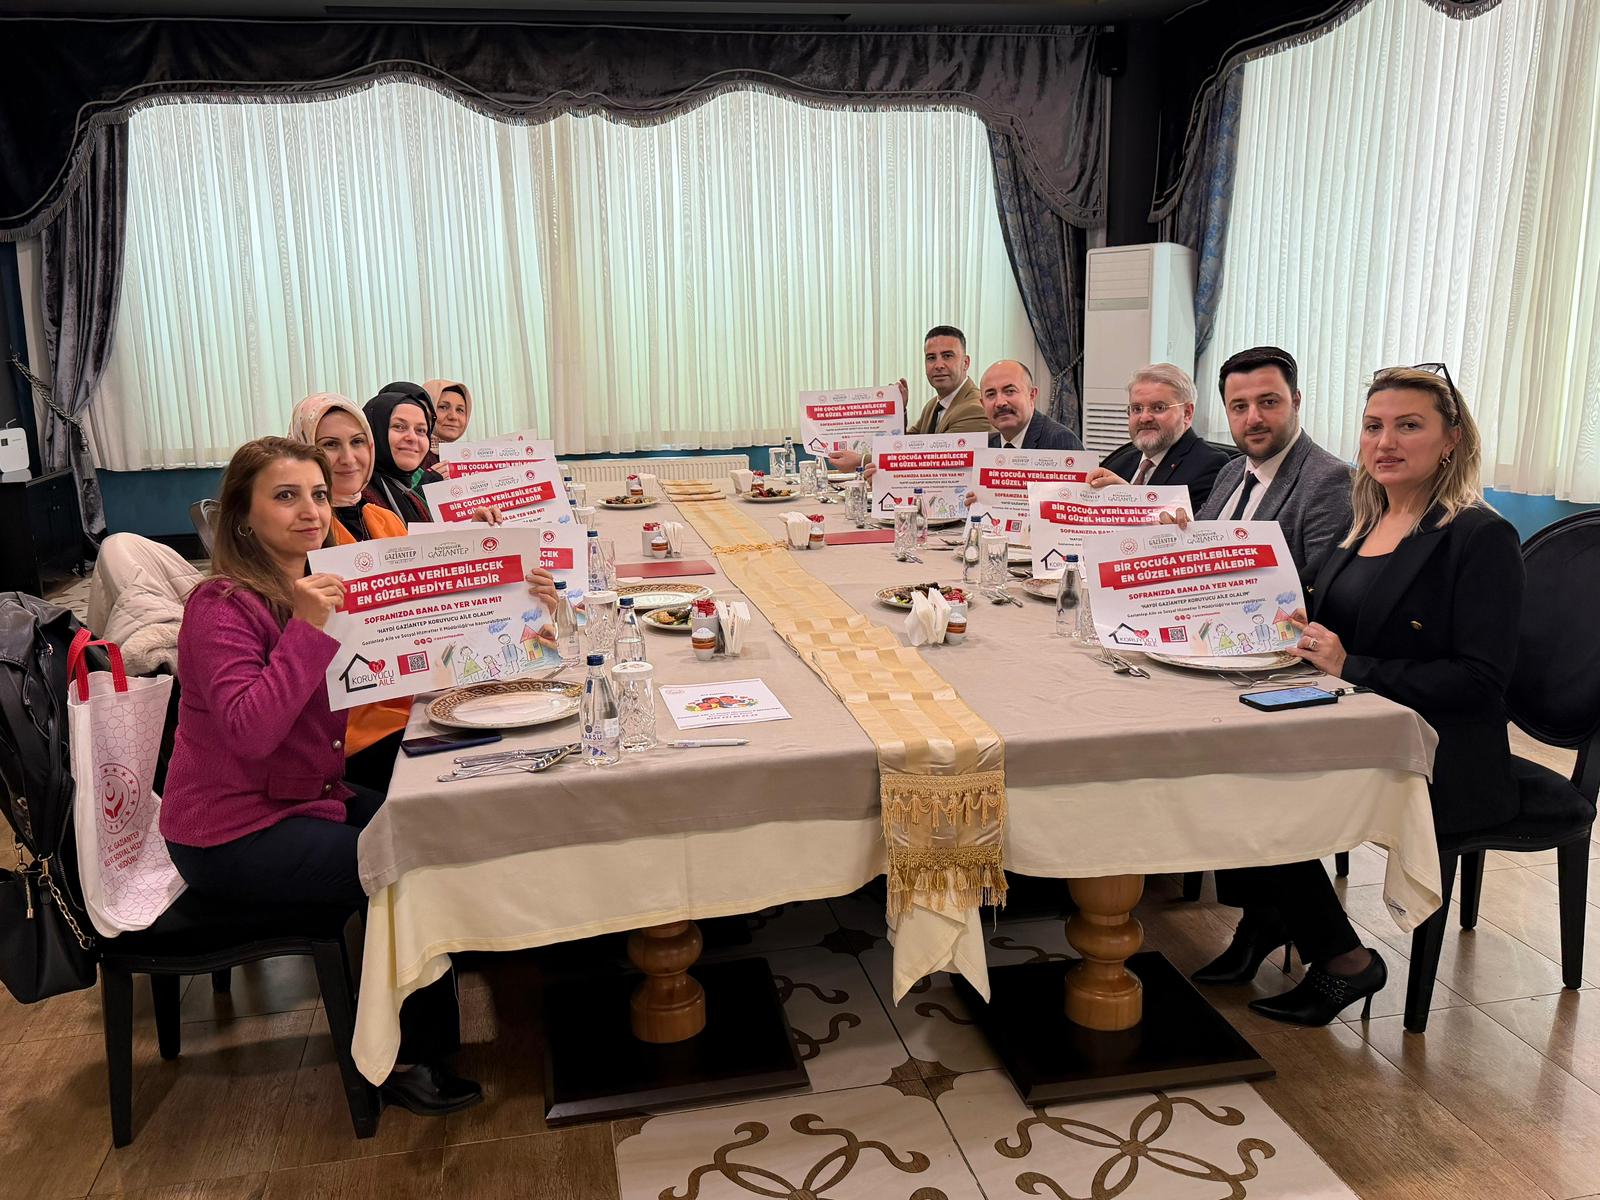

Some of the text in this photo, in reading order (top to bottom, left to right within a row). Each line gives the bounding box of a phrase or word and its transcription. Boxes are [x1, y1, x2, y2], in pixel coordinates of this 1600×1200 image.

[1000, 471, 1026, 479] ÇOCUĞA
[1027, 472, 1076, 480] VERİLEBİLECEK
[450, 503, 462, 511] BİR
[463, 497, 491, 508] ÇOCUĞA
[492, 486, 543, 502] VERİLEBİLECEK
[515, 494, 542, 506] AİLEDİR
[1052, 503, 1064, 511] BİR
[1066, 505, 1098, 515] ÇOCUĞA
[1068, 514, 1094, 522] GÜZEL
[1095, 515, 1125, 523] HEDİYE
[1114, 548, 1259, 573] BİR ÇOCUĞA VERİLEBİLECEK
[350, 560, 504, 594] BİR ÇOCUĞA VERİLEBİLECEK
[1121, 558, 1256, 583] EN GÜZEL HEDİYE AİLEDİR
[357, 574, 500, 606] EN GÜZEL HEDİYE AİLEDİR
[1129, 589, 1176, 600] SOFRANIZDA
[1176, 587, 1198, 595] BANA
[364, 609, 414, 624] SOFRANIZDA
[416, 604, 439, 615] BANA
[396, 620, 427, 631] GAZİANTEP
[428, 616, 459, 625] KORUYUCU
[352, 670, 394, 685] KORUYUCU
